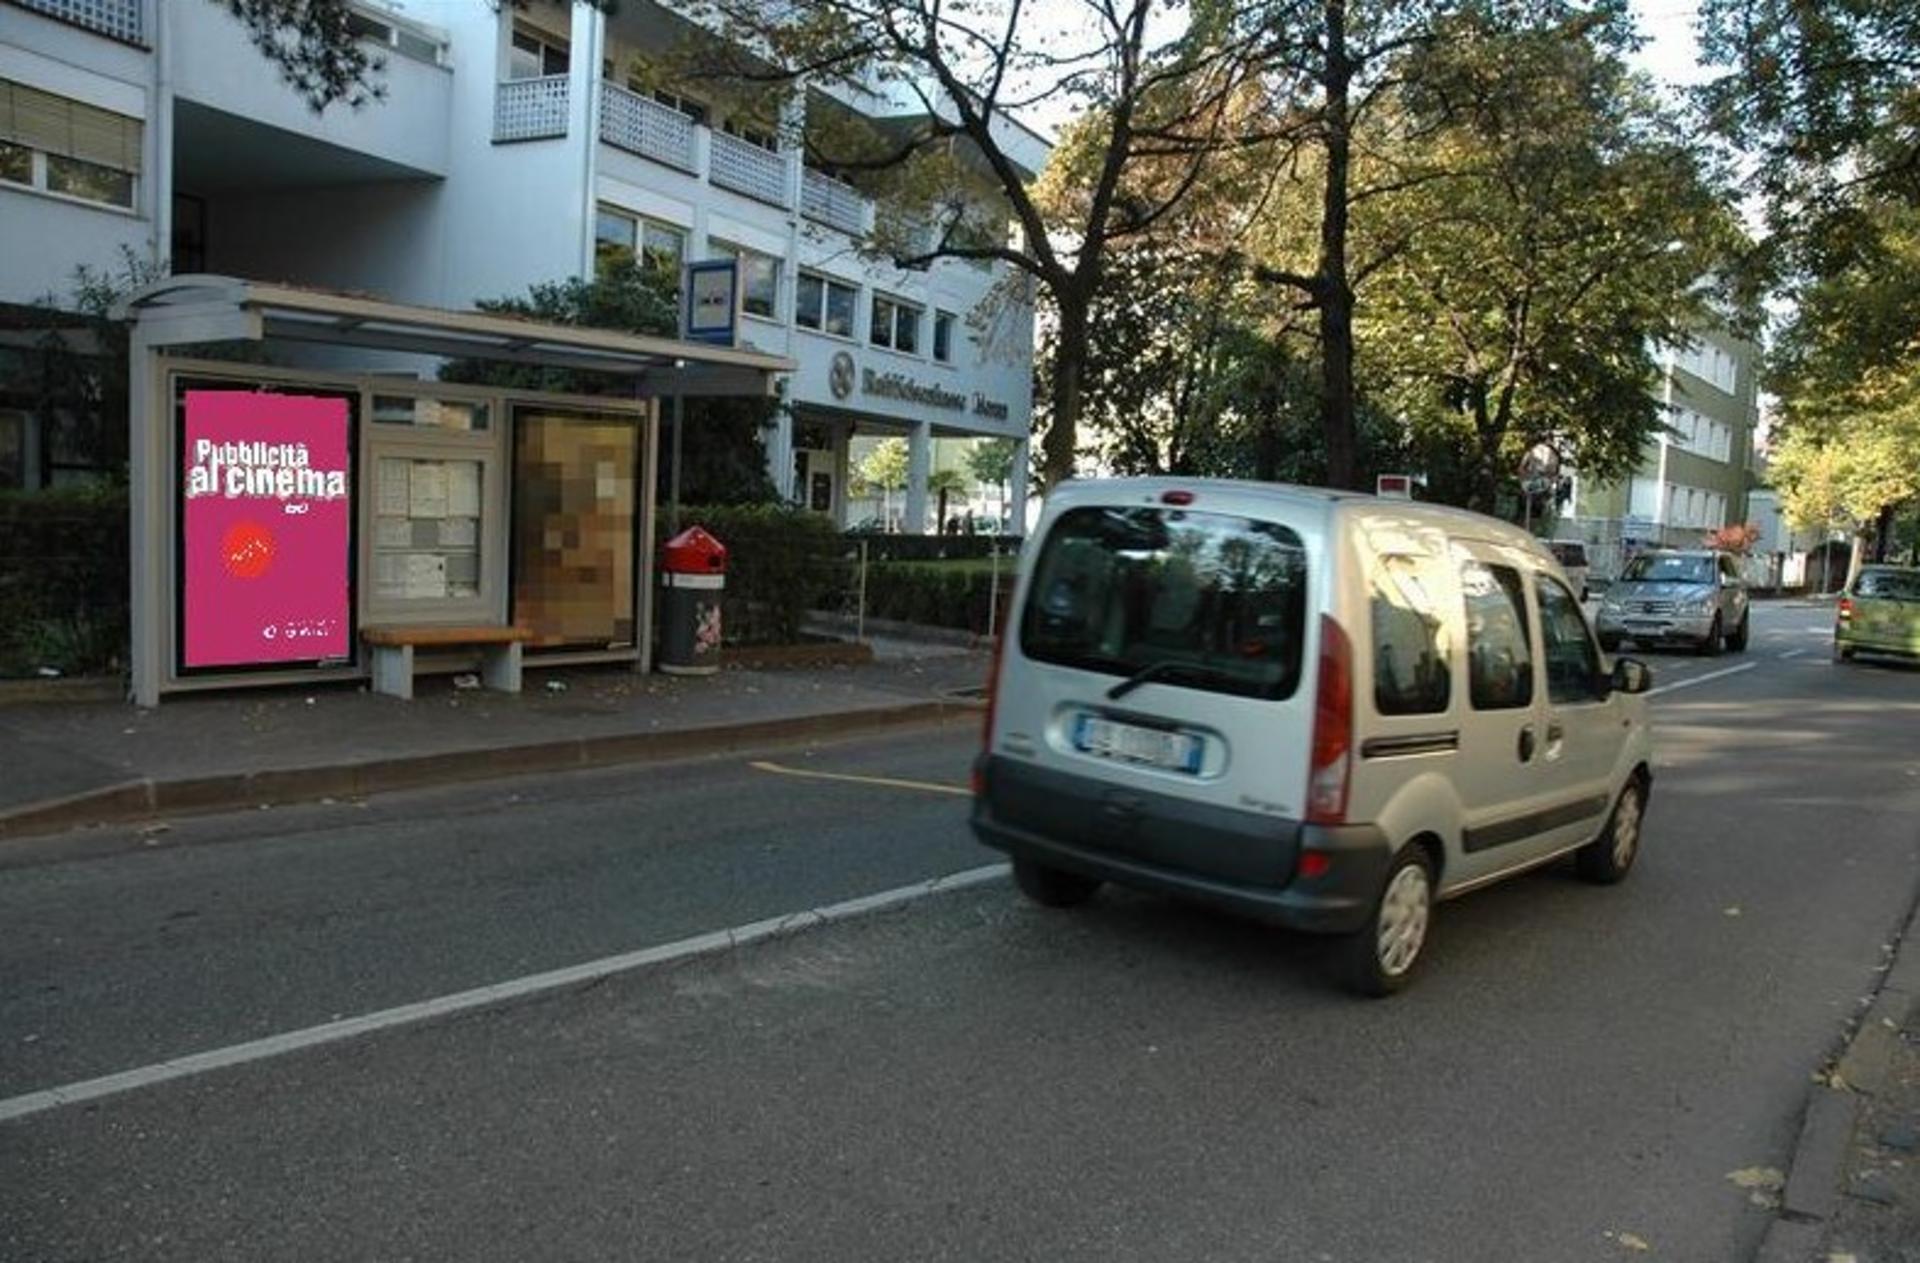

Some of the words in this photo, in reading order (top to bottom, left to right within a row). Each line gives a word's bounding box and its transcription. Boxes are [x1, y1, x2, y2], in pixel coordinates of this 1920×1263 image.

[195, 438, 310, 467] Pubblicità
[188, 456, 219, 496] al
[224, 463, 346, 498] cinema
